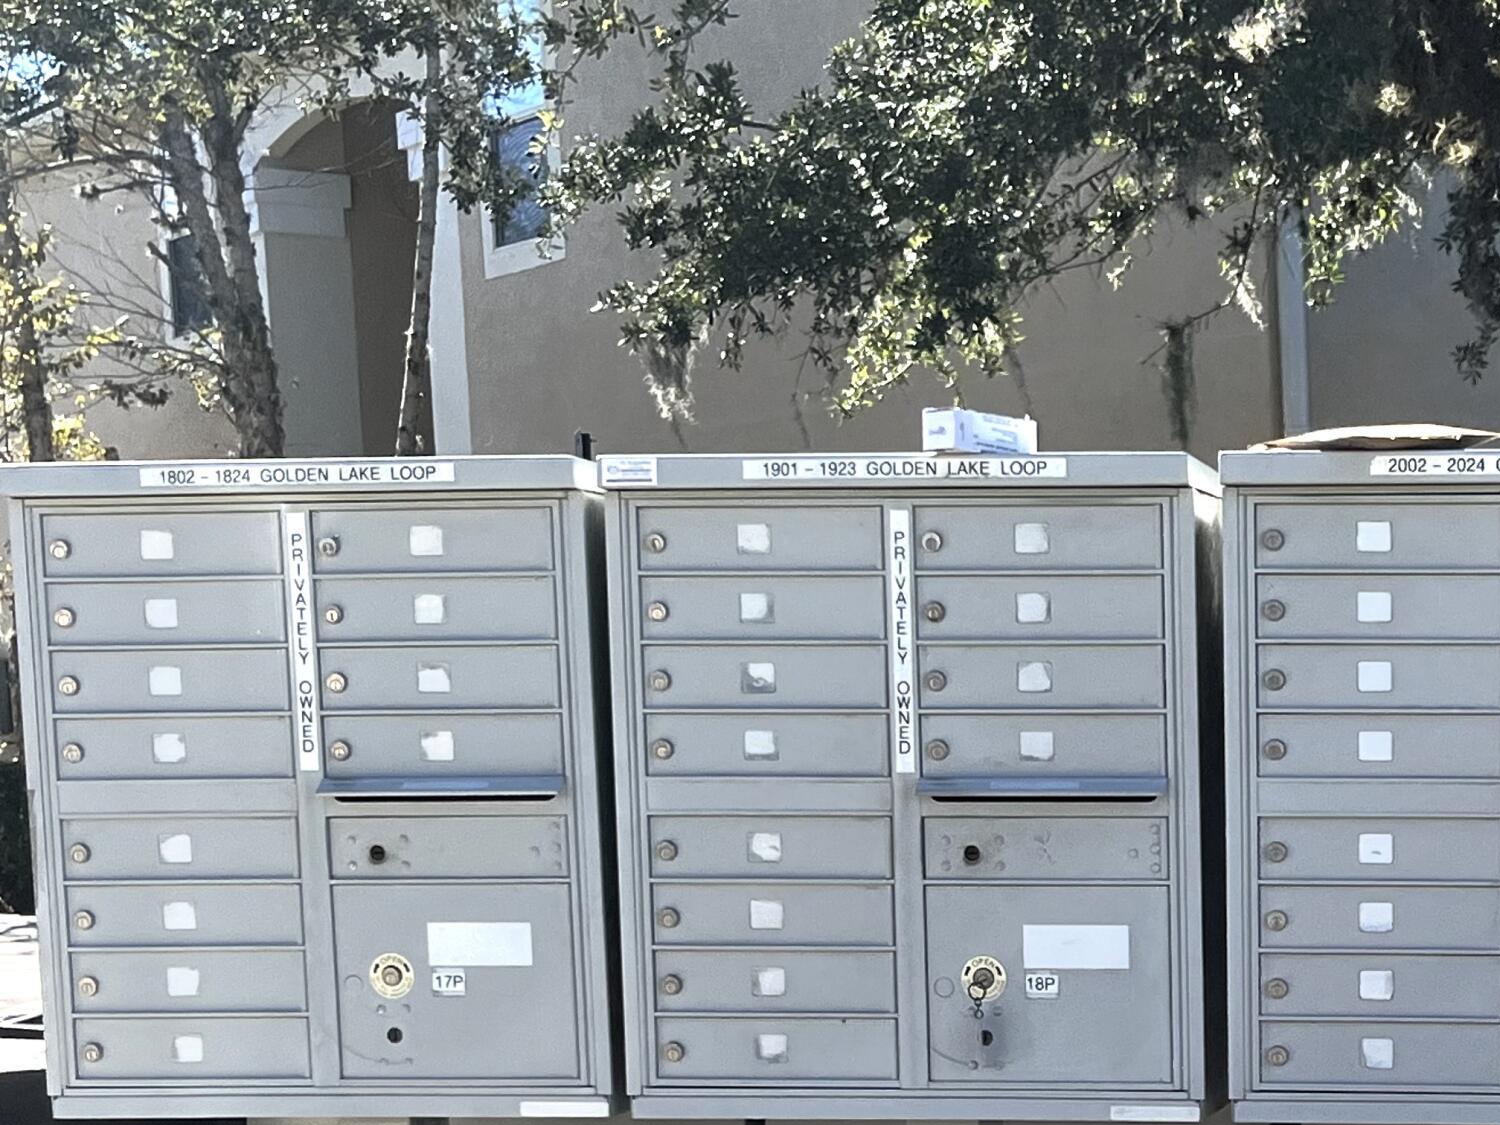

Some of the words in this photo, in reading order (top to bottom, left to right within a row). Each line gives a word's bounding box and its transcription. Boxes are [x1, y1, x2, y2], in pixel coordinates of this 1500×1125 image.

[160, 469, 195, 484] 1802
[216, 469, 250, 483] 1824
[260, 467, 329, 483] GOLDEN
[339, 466, 380, 481] LAKE
[390, 465, 436, 481] LOOP
[763, 462, 798, 477] 1901
[820, 461, 856, 476] 1923
[866, 461, 937, 476] GOLDEN
[947, 461, 989, 476] LAKE
[1001, 461, 1047, 475] LOOP
[1388, 457, 1427, 473] 2002
[1447, 457, 1485, 472] 2024
[291, 533, 309, 665] PRIVATELY
[894, 531, 911, 665] PRIVATELY
[299, 681, 315, 753] OWNED
[897, 681, 912, 755] OWNED
[435, 975, 464, 988] 17P
[1026, 977, 1055, 991] 18P
